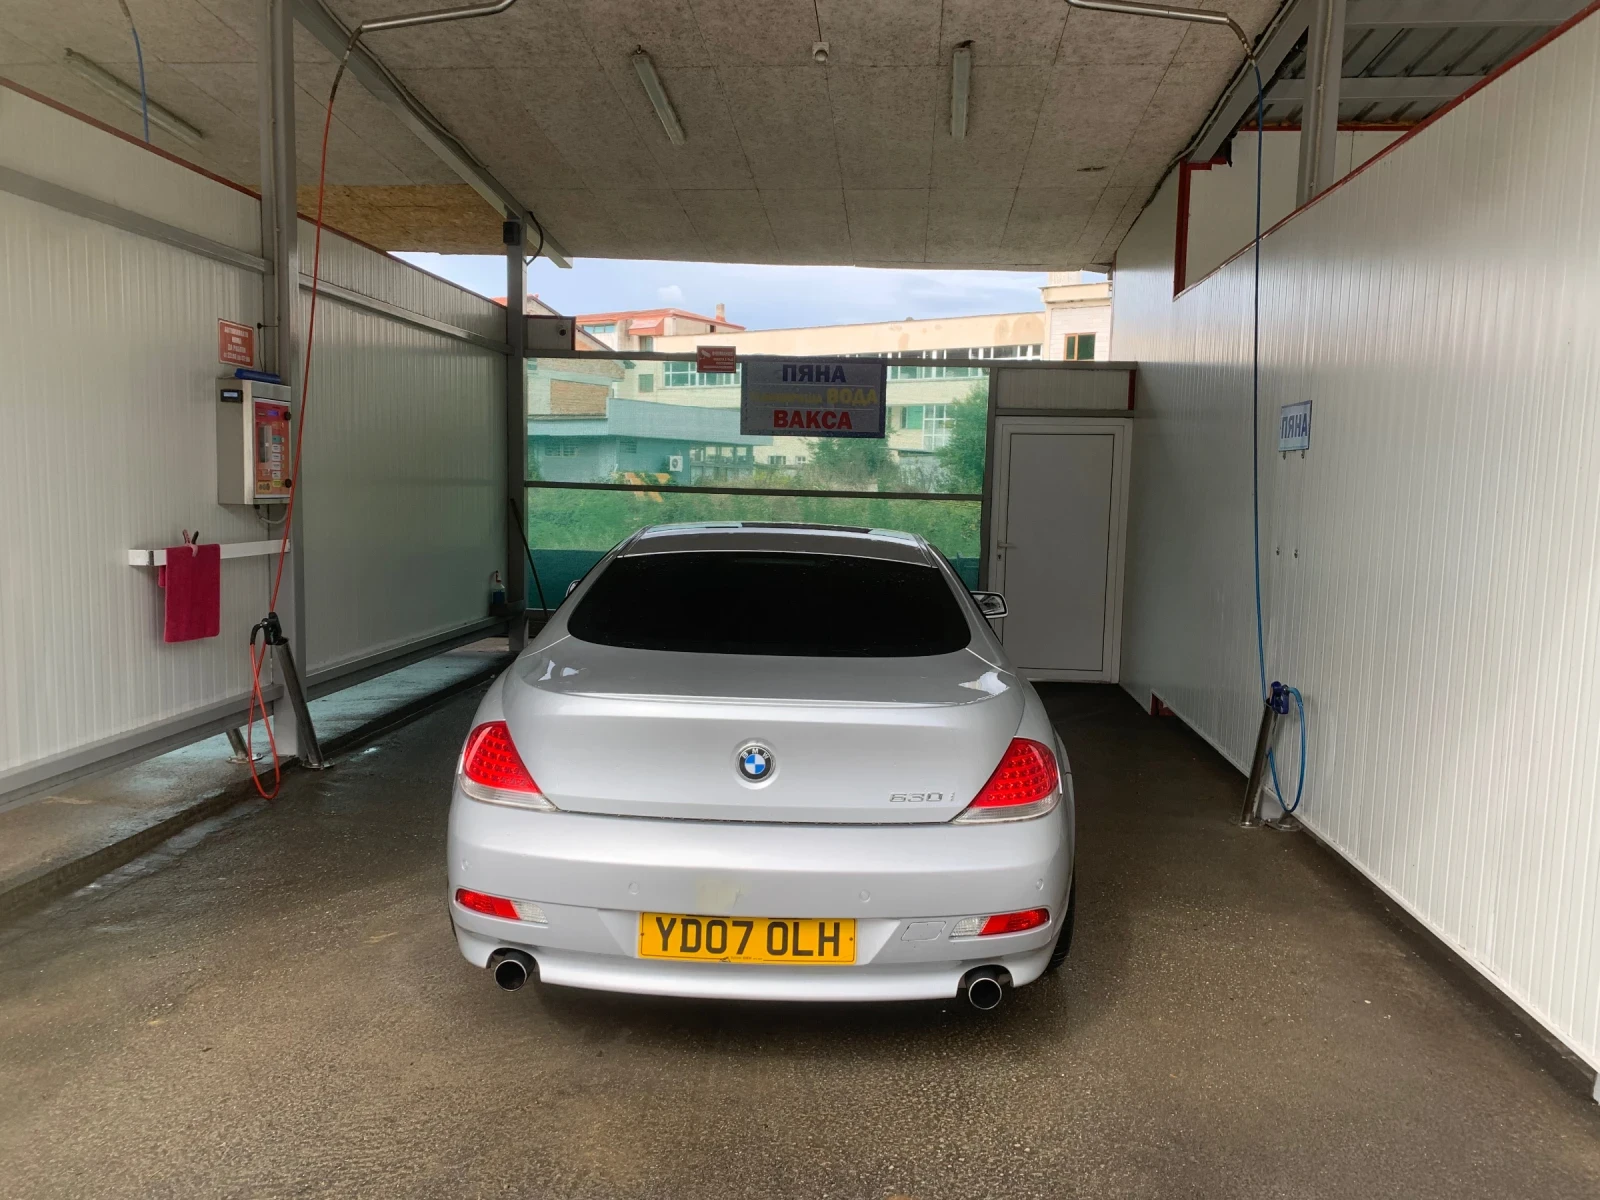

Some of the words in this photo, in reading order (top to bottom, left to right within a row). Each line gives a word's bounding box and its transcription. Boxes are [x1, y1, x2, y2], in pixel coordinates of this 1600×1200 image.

[782, 364, 846, 383] ПЯНА
[826, 387, 878, 406] ВОДА
[773, 409, 853, 430] ВАКСА
[1280, 412, 1308, 439] ПЯНА
[741, 747, 771, 760] BMW
[655, 916, 754, 956] YD07
[766, 921, 841, 957] OLH
